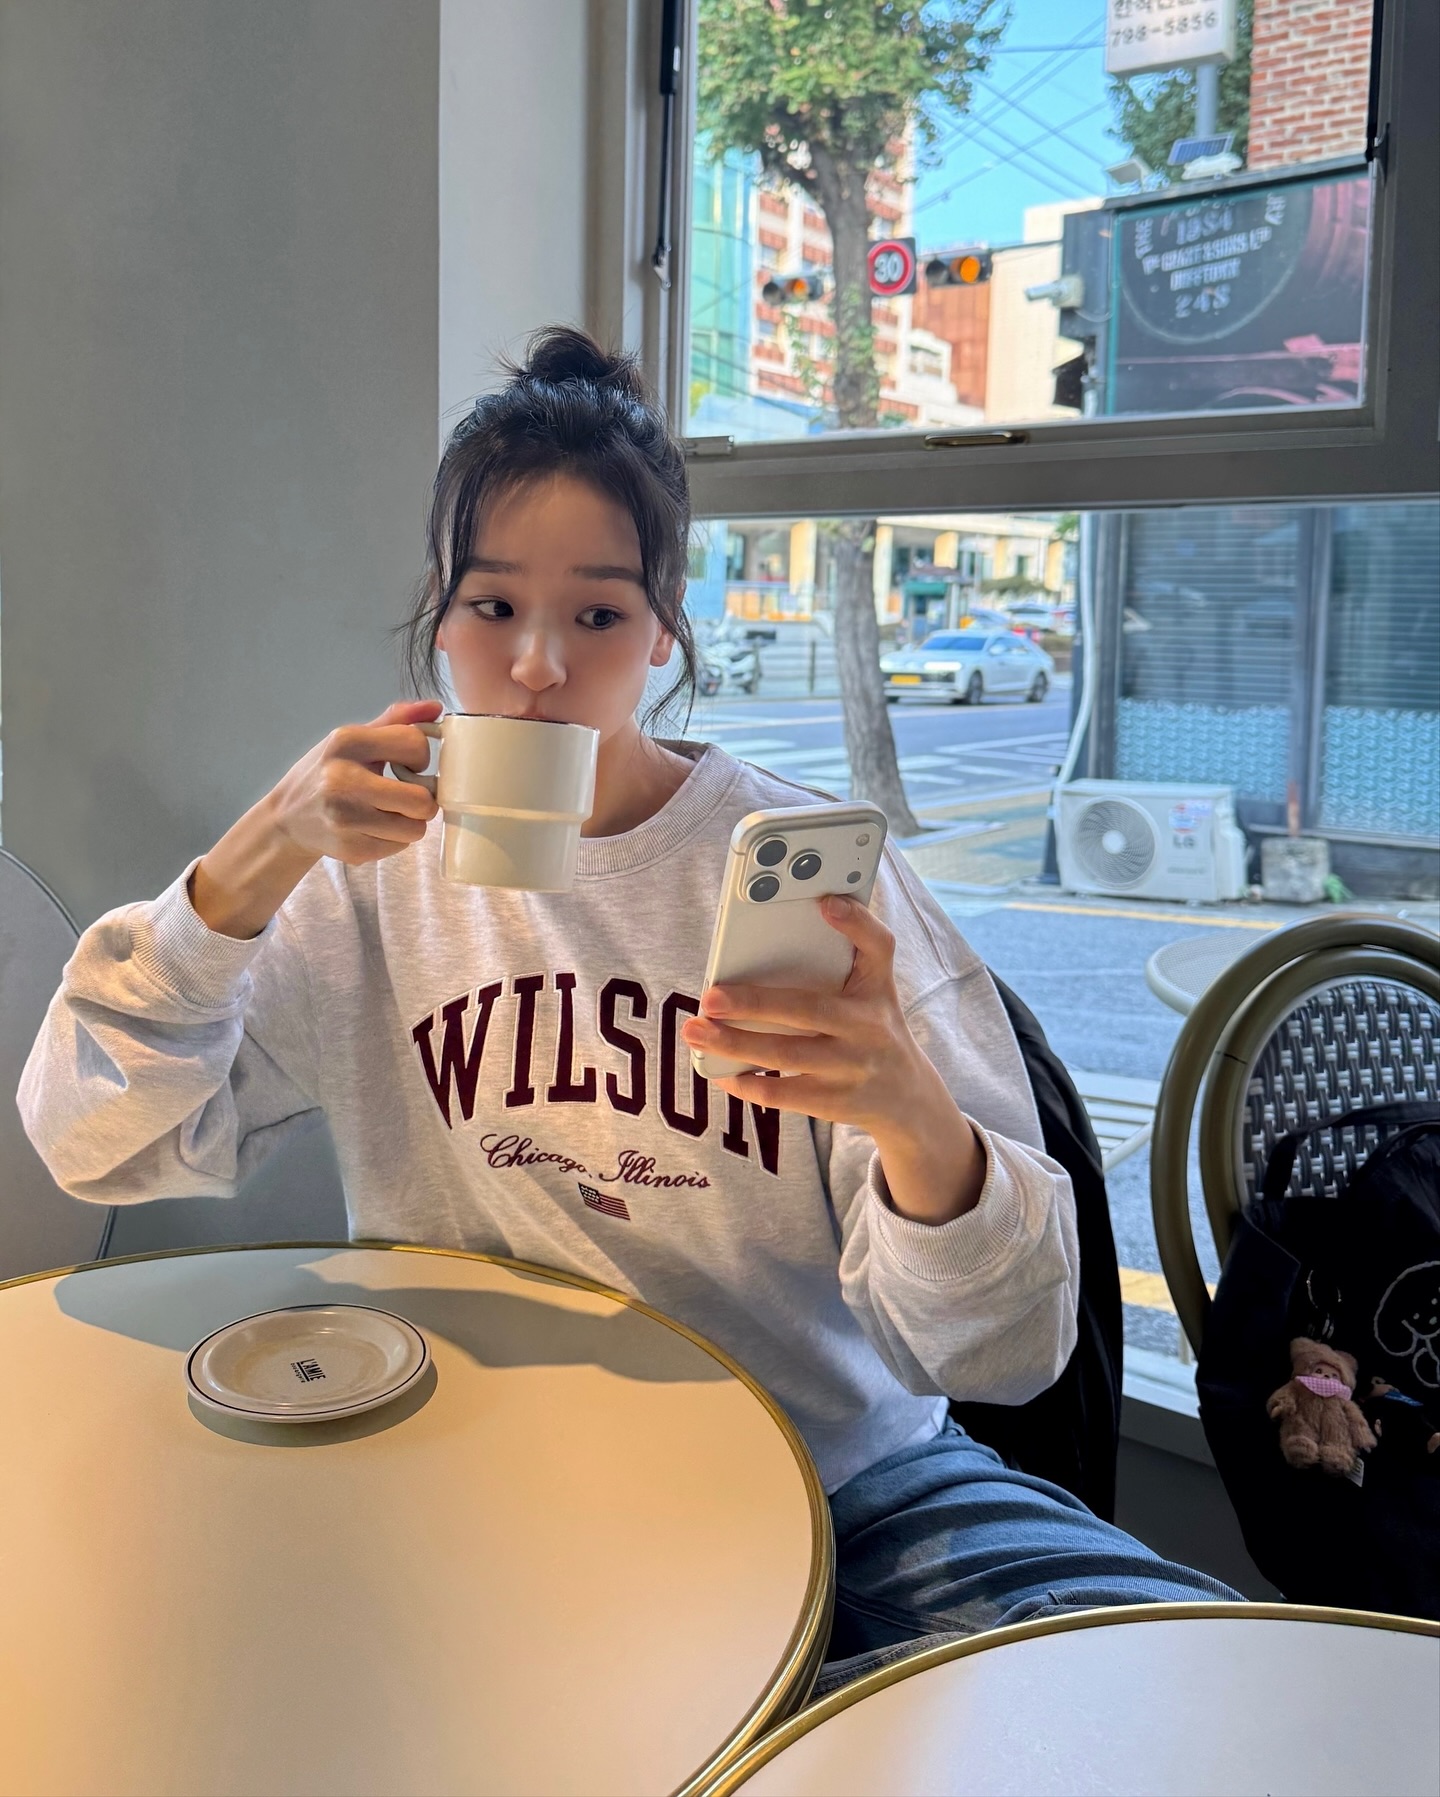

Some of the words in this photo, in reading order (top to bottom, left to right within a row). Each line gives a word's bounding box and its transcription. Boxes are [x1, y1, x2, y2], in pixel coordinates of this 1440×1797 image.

[874, 252, 904, 283] 30
[599, 1150, 711, 1188] Illinois
[300, 1358, 326, 1381] L'AMIE
